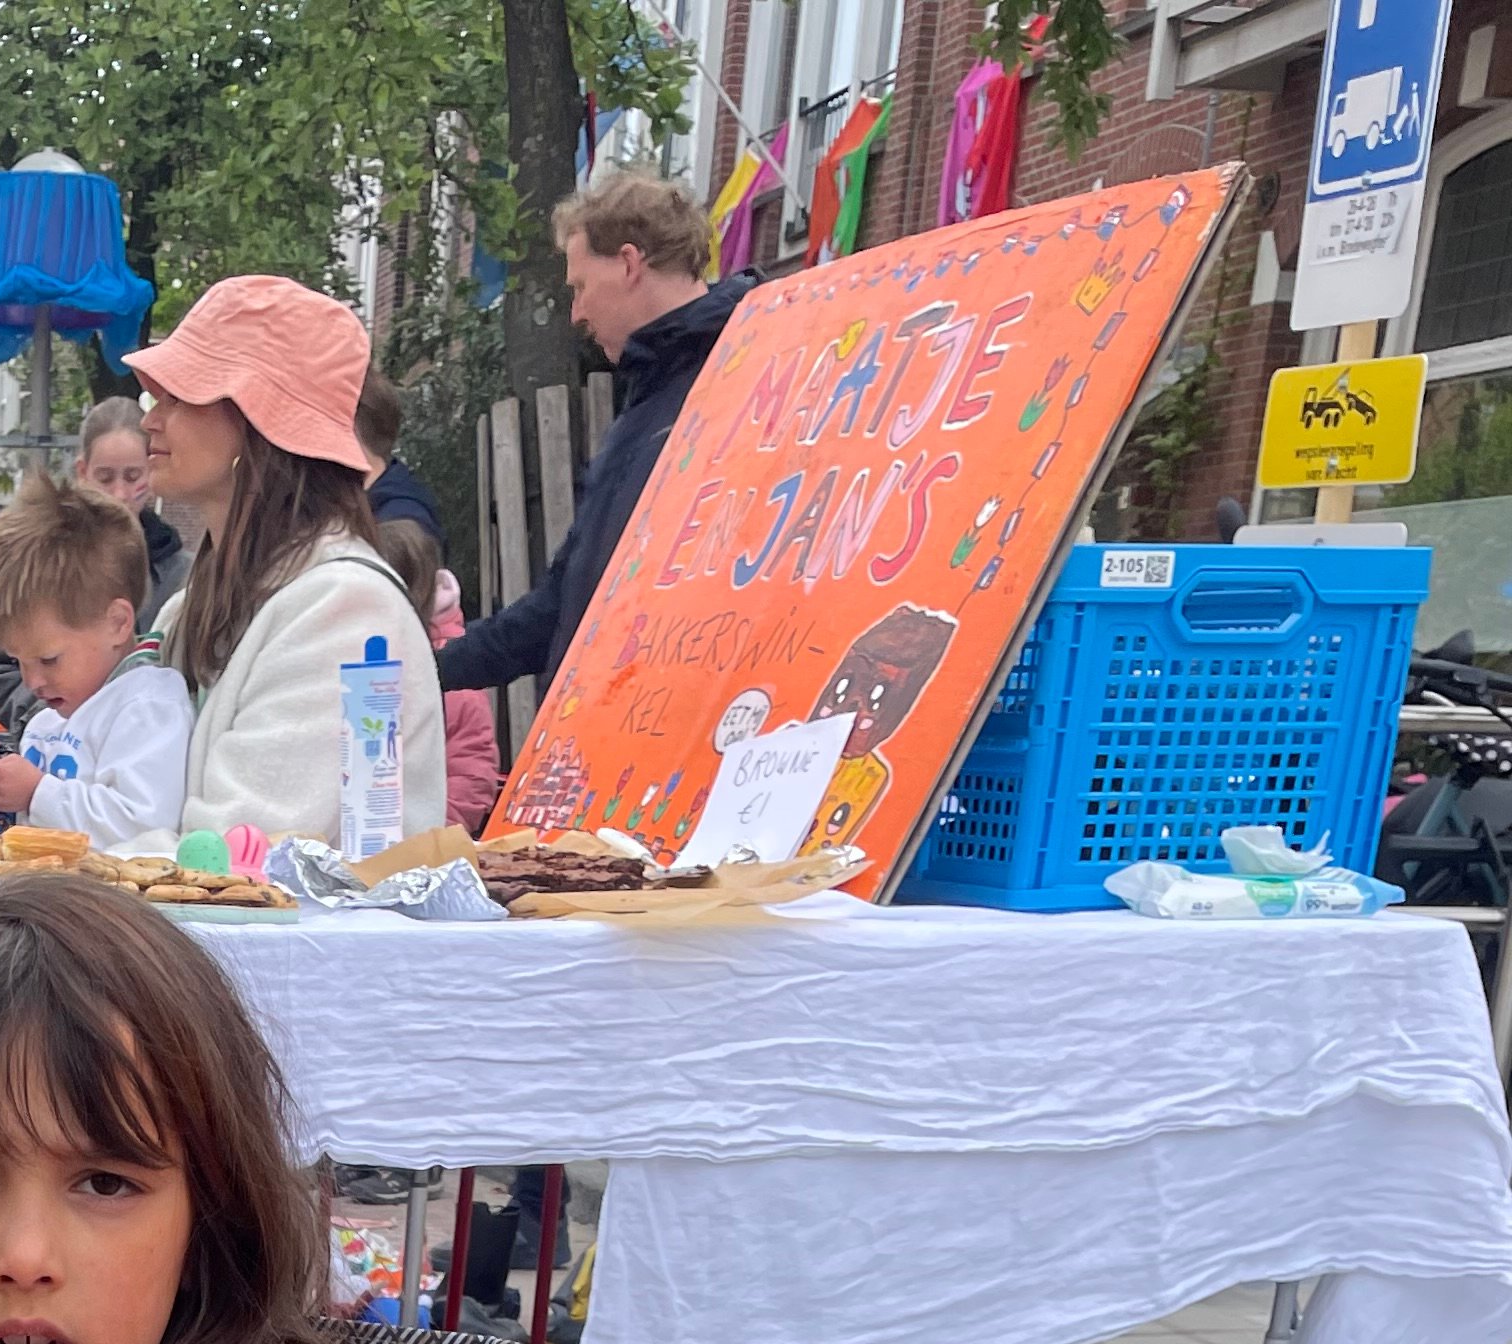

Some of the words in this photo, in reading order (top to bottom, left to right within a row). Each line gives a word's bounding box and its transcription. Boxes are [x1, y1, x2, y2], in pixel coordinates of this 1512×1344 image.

[712, 292, 1034, 464] MAATJE
[654, 479, 757, 589] EN
[731, 450, 962, 590] JAN'S
[1105, 558, 1145, 573] 2-105
[619, 685, 672, 736] KEL
[737, 792, 772, 825] €1
